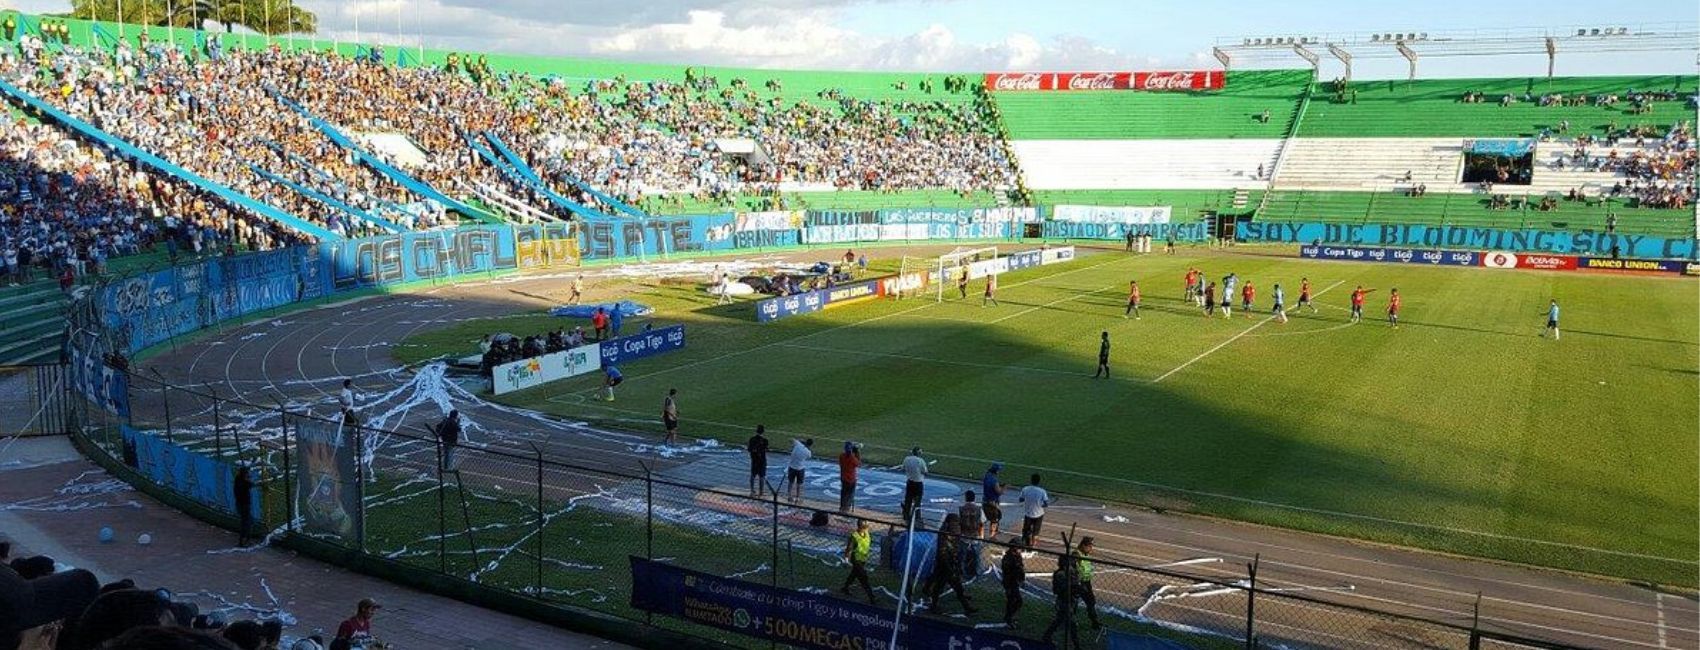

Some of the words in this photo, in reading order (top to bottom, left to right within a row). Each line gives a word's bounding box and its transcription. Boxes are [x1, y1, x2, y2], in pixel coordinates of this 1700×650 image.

[994, 73, 1041, 90] Coca-Cola
[1068, 73, 1115, 90] Coca-Cola
[1144, 72, 1192, 89] Coca-Cola
[1244, 221, 1303, 243] SOY
[1324, 222, 1365, 244] DE
[1572, 229, 1643, 257] SOY
[1324, 247, 1345, 257] Copa
[1347, 248, 1364, 259] Tigo
[333, 234, 404, 290] LOS
[1589, 258, 1622, 268] BANCO
[1625, 260, 1659, 270] UNION
[623, 339, 645, 354] Copa
[647, 334, 663, 349] Tigo
